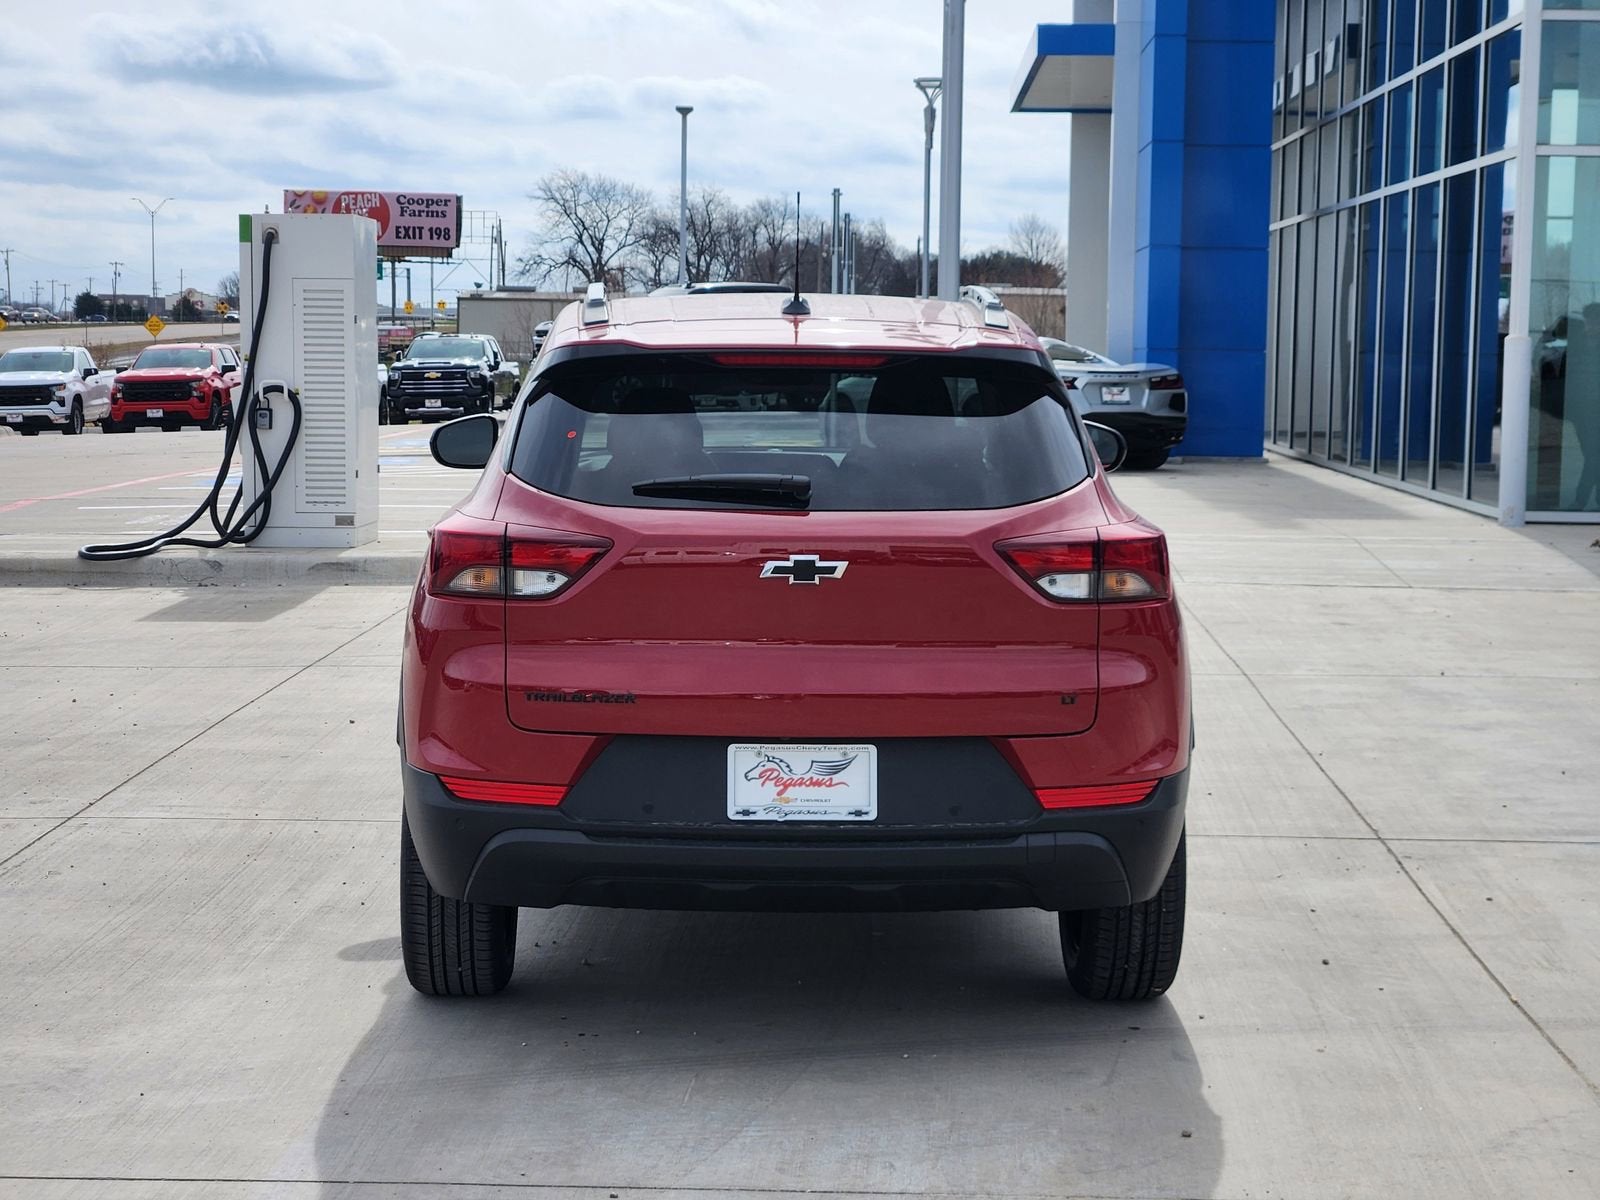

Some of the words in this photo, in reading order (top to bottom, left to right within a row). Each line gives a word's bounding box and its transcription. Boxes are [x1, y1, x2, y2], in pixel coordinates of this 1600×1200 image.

[341, 192, 380, 208] PEACH
[396, 194, 452, 208] Cooper
[399, 206, 447, 219] Farms
[395, 225, 424, 240] EXIT
[428, 226, 451, 241] 198
[525, 691, 636, 704] TRAILBLAZER
[758, 768, 849, 797] Pegasus
[763, 806, 842, 819] Pegasus
